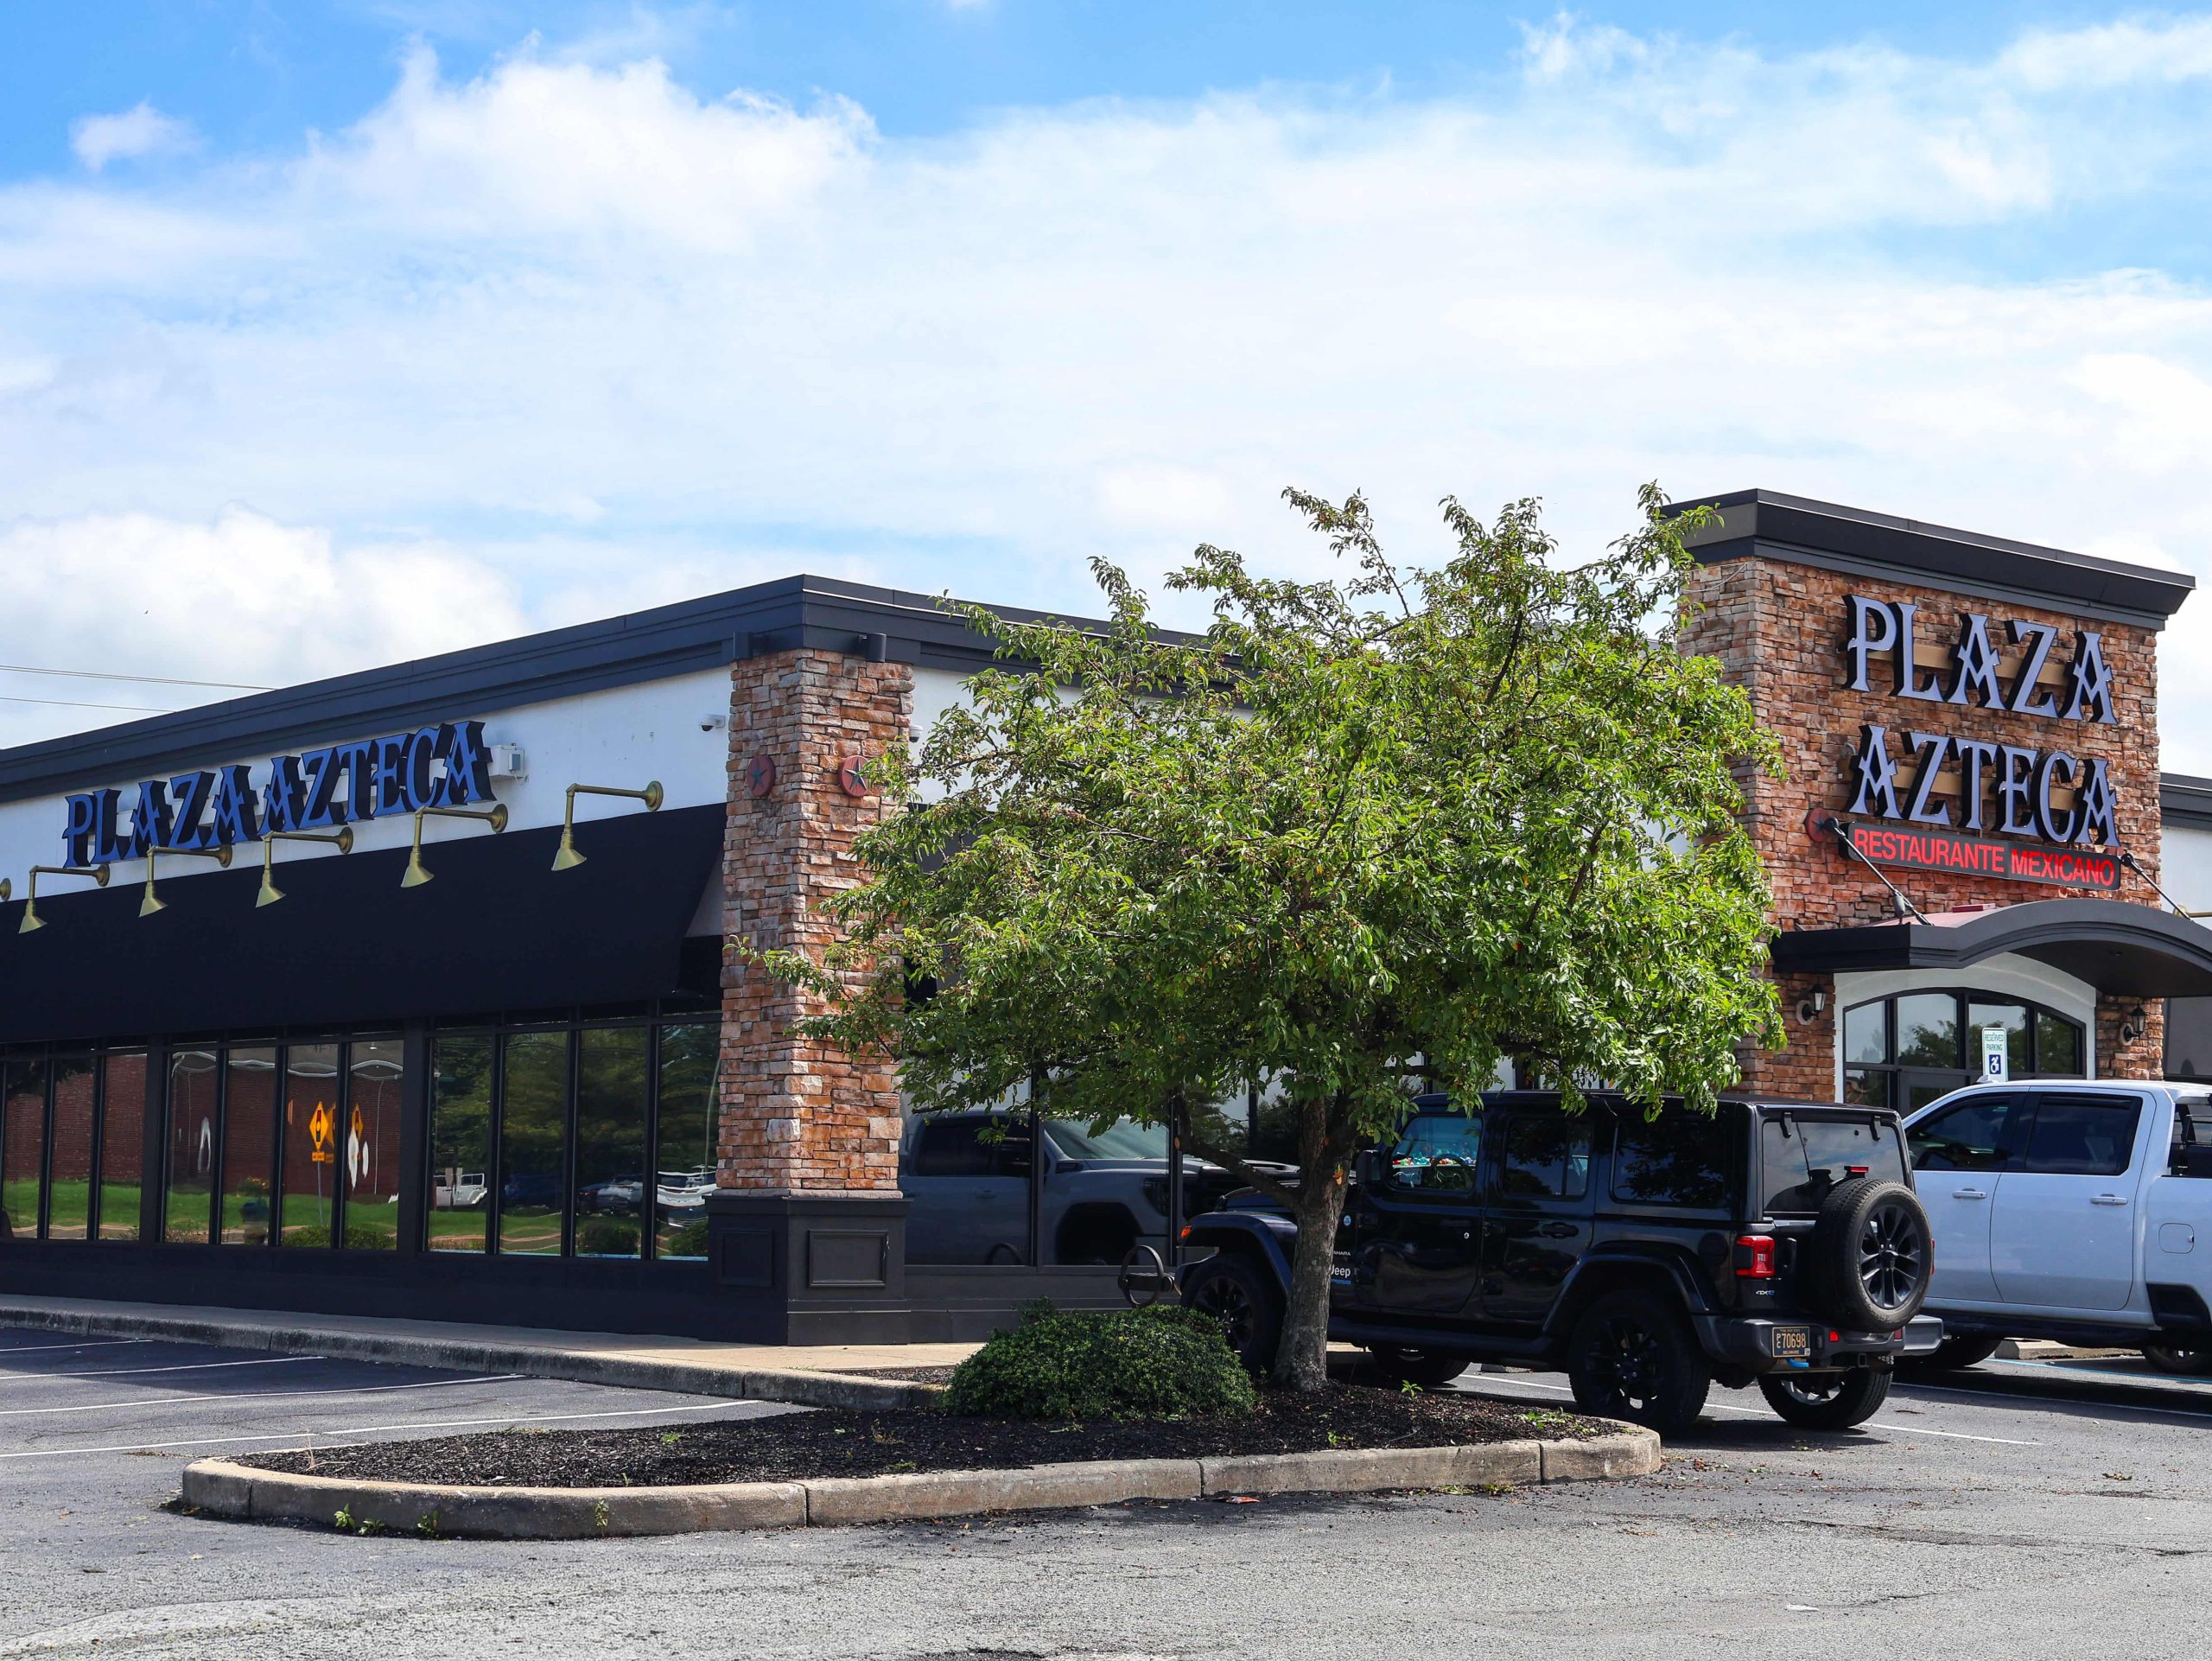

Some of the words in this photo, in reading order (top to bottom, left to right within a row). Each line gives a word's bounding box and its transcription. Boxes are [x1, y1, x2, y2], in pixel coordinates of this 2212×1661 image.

[1842, 594, 2119, 724] PLAZA
[62, 764, 258, 869] PLAZA
[258, 720, 497, 834] AZTECA
[1844, 724, 2121, 847] AZTECA
[1853, 829, 2005, 873] RESTAURANTE
[2011, 849, 2115, 887] MEXICANO
[1984, 1034, 2005, 1042] RESERVED
[1331, 1264, 1351, 1278] Jeep
